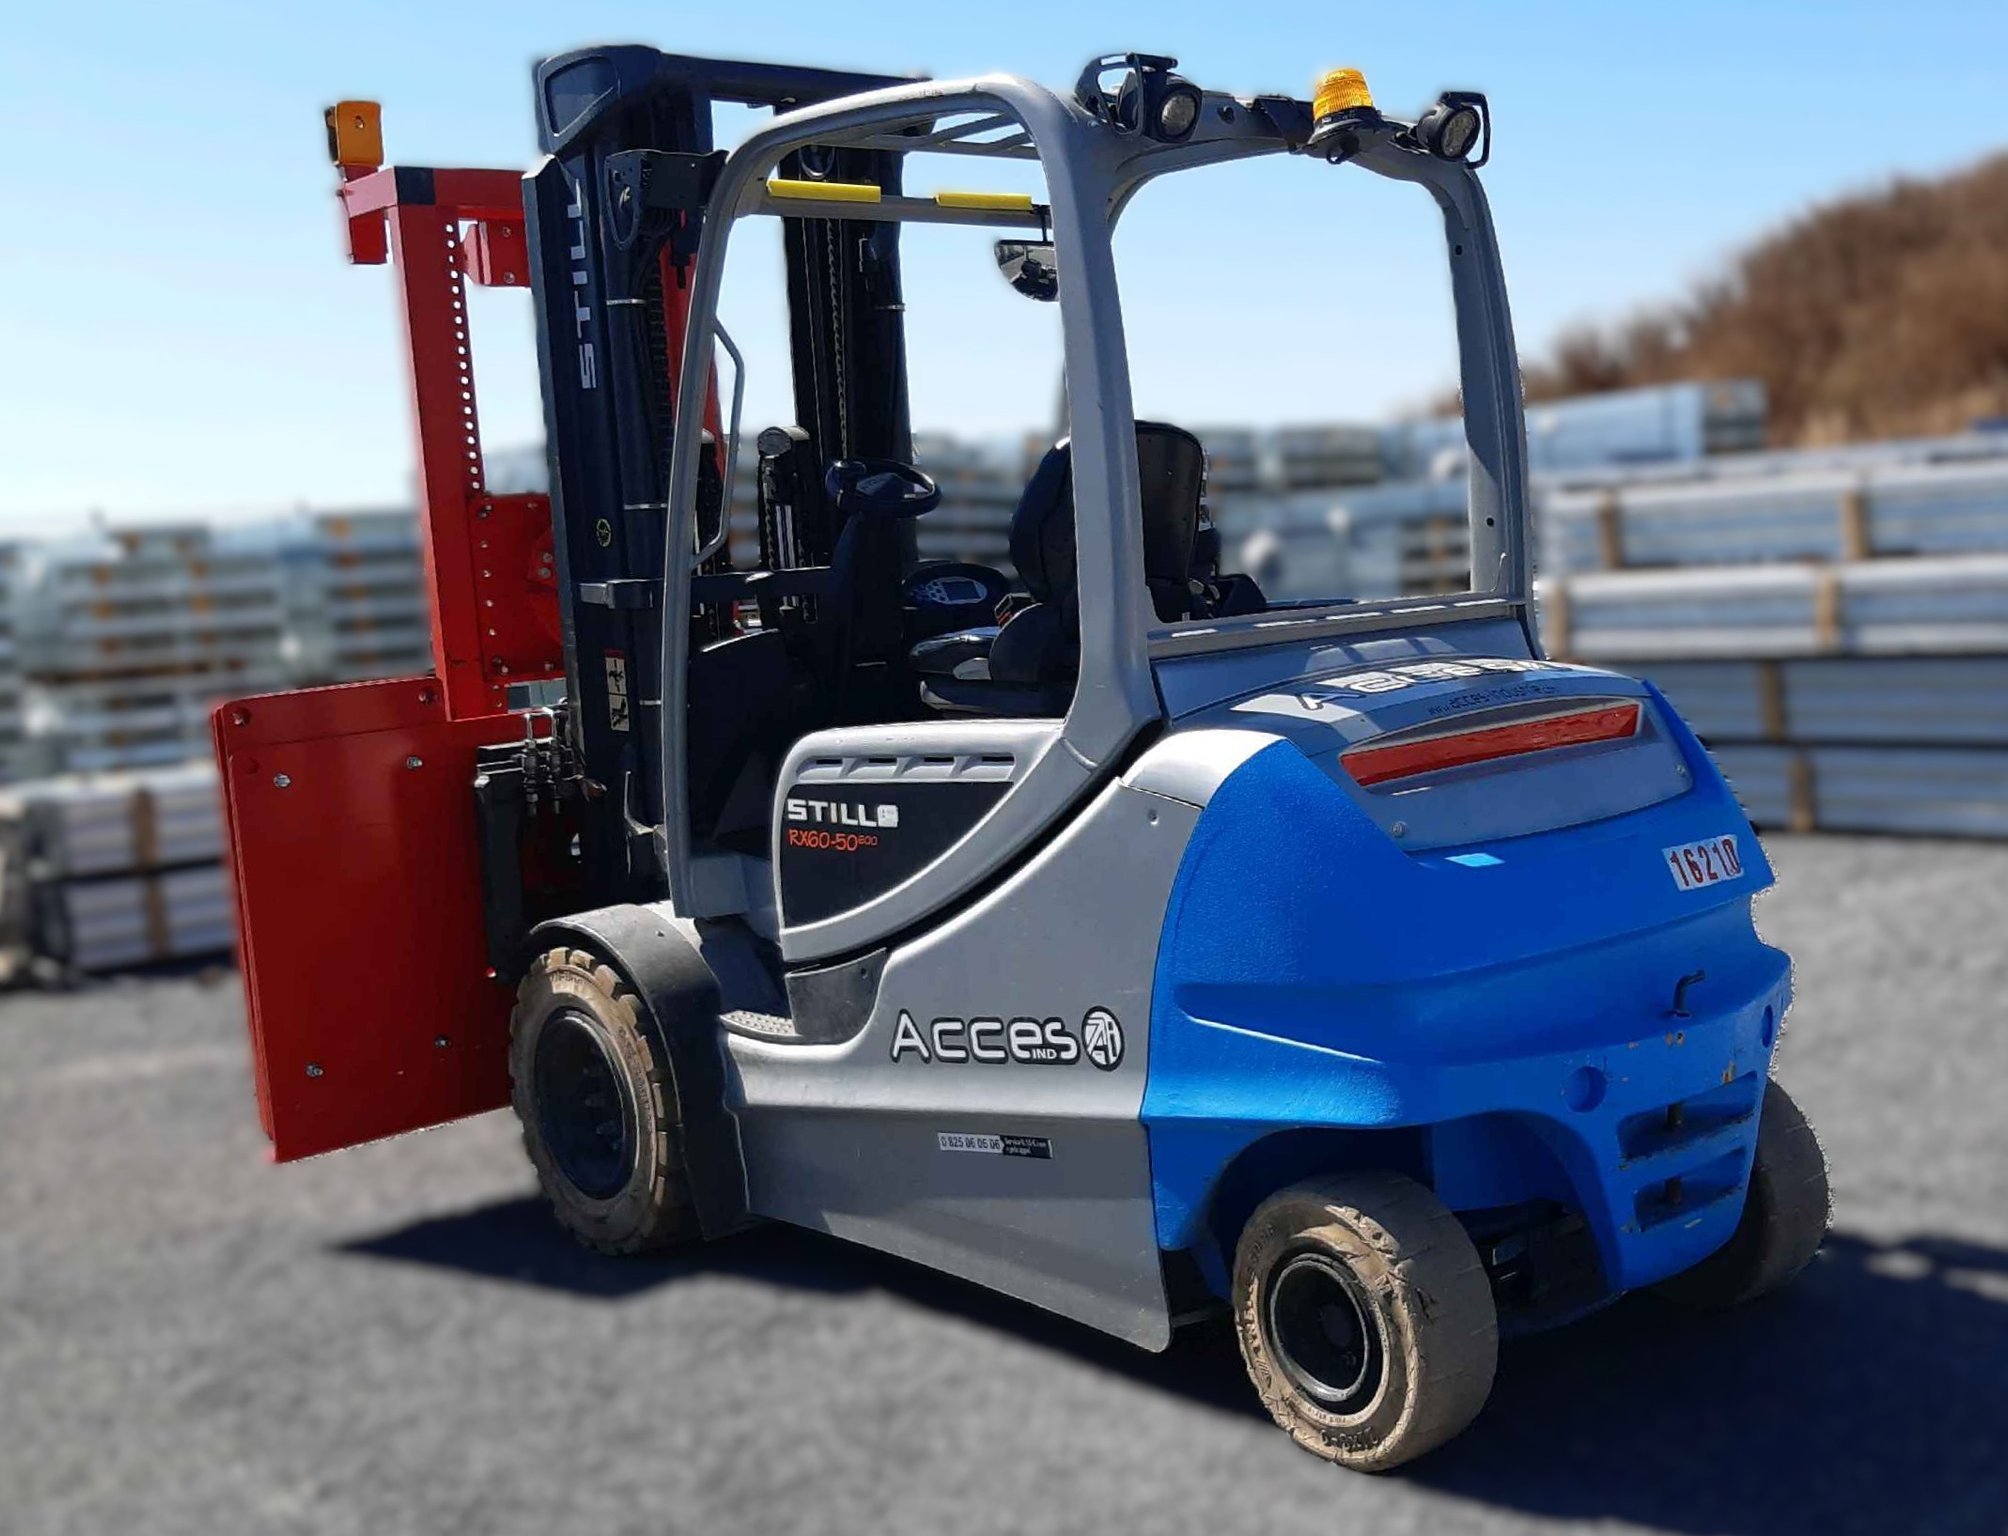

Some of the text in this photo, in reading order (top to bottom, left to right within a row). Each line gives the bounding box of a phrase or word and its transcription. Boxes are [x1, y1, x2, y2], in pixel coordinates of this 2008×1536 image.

[566, 178, 598, 390] STILL
[786, 798, 878, 828] STILL
[1669, 839, 1741, 887] 16210
[891, 1009, 1080, 1064] Acces
[1031, 1048, 1058, 1060] IND
